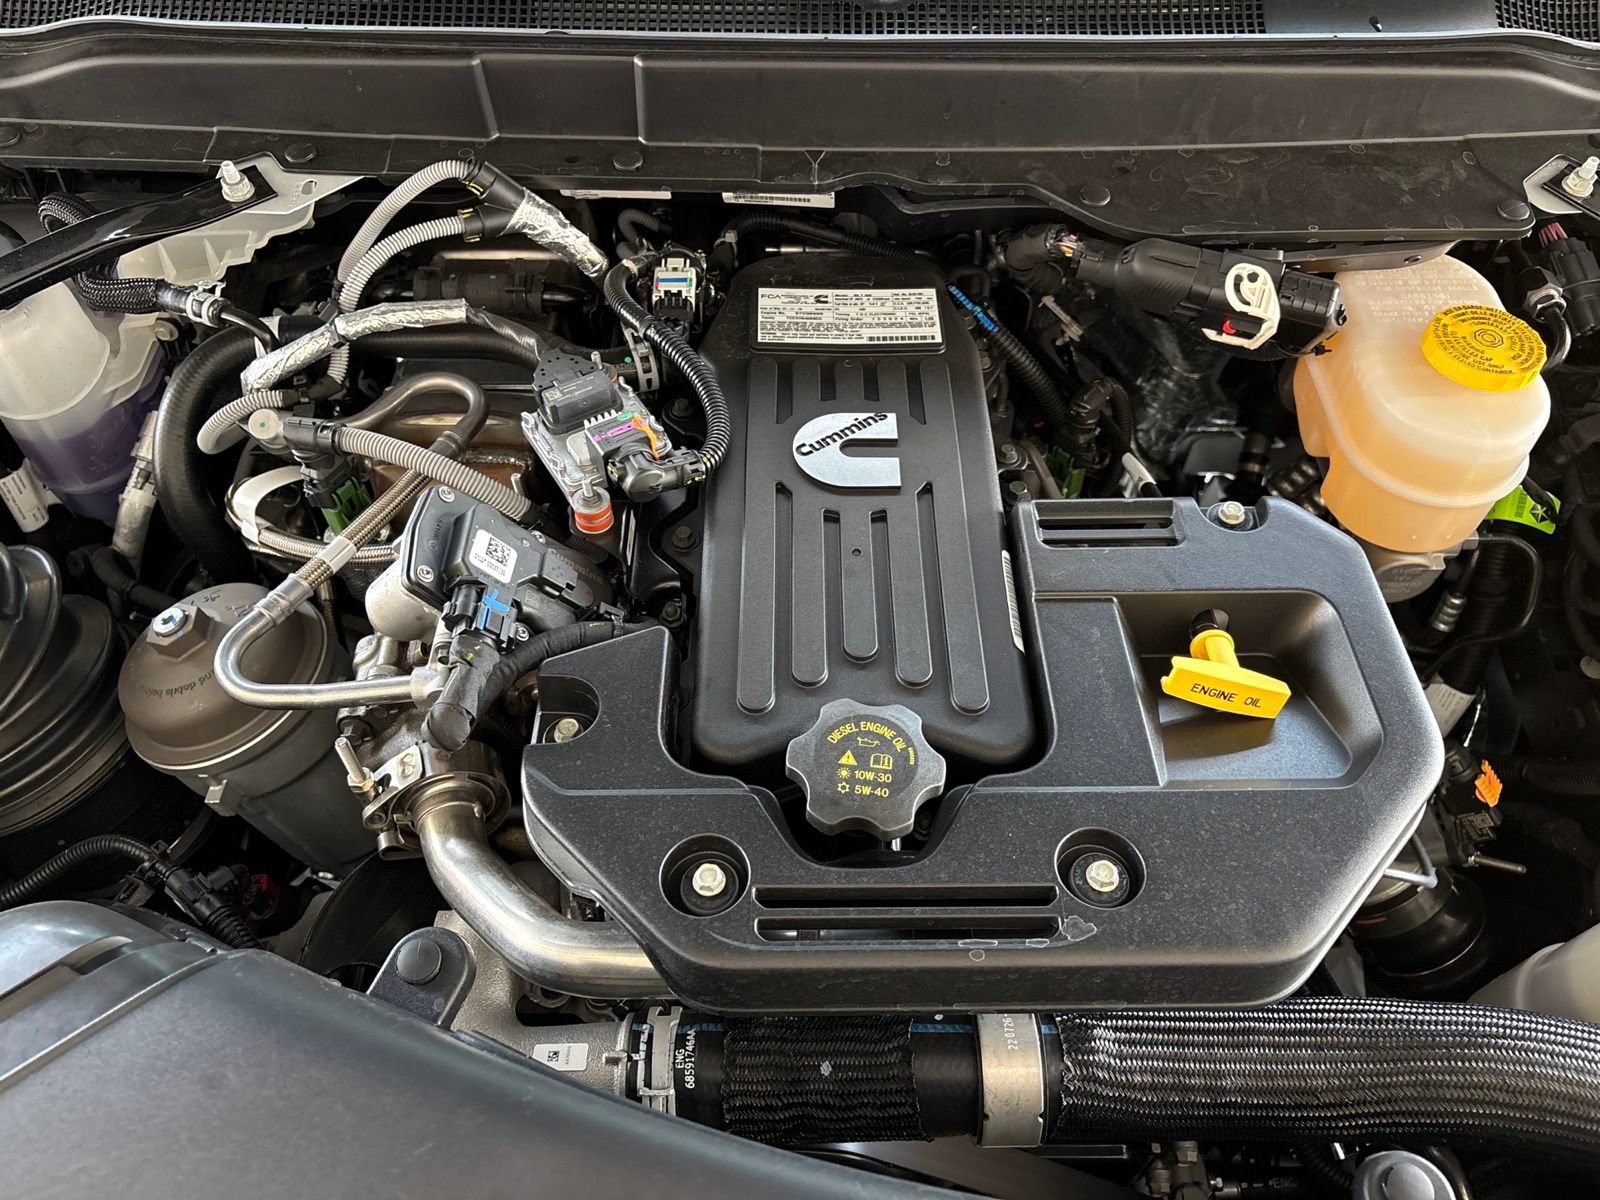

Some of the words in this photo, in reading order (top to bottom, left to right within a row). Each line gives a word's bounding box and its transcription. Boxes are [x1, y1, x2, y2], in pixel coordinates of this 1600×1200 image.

[795, 411, 889, 457] Cummins
[1190, 683, 1238, 702] ENGINE
[1244, 696, 1261, 708] OIL
[827, 722, 859, 744] DIESEL
[860, 721, 896, 740] ENGINE
[892, 737, 907, 752] OIL
[854, 770, 892, 783] 10W-30
[854, 784, 889, 797] 5W-40
[675, 1048, 685, 1069] ENG
[684, 1028, 697, 1089] 68591746AA
